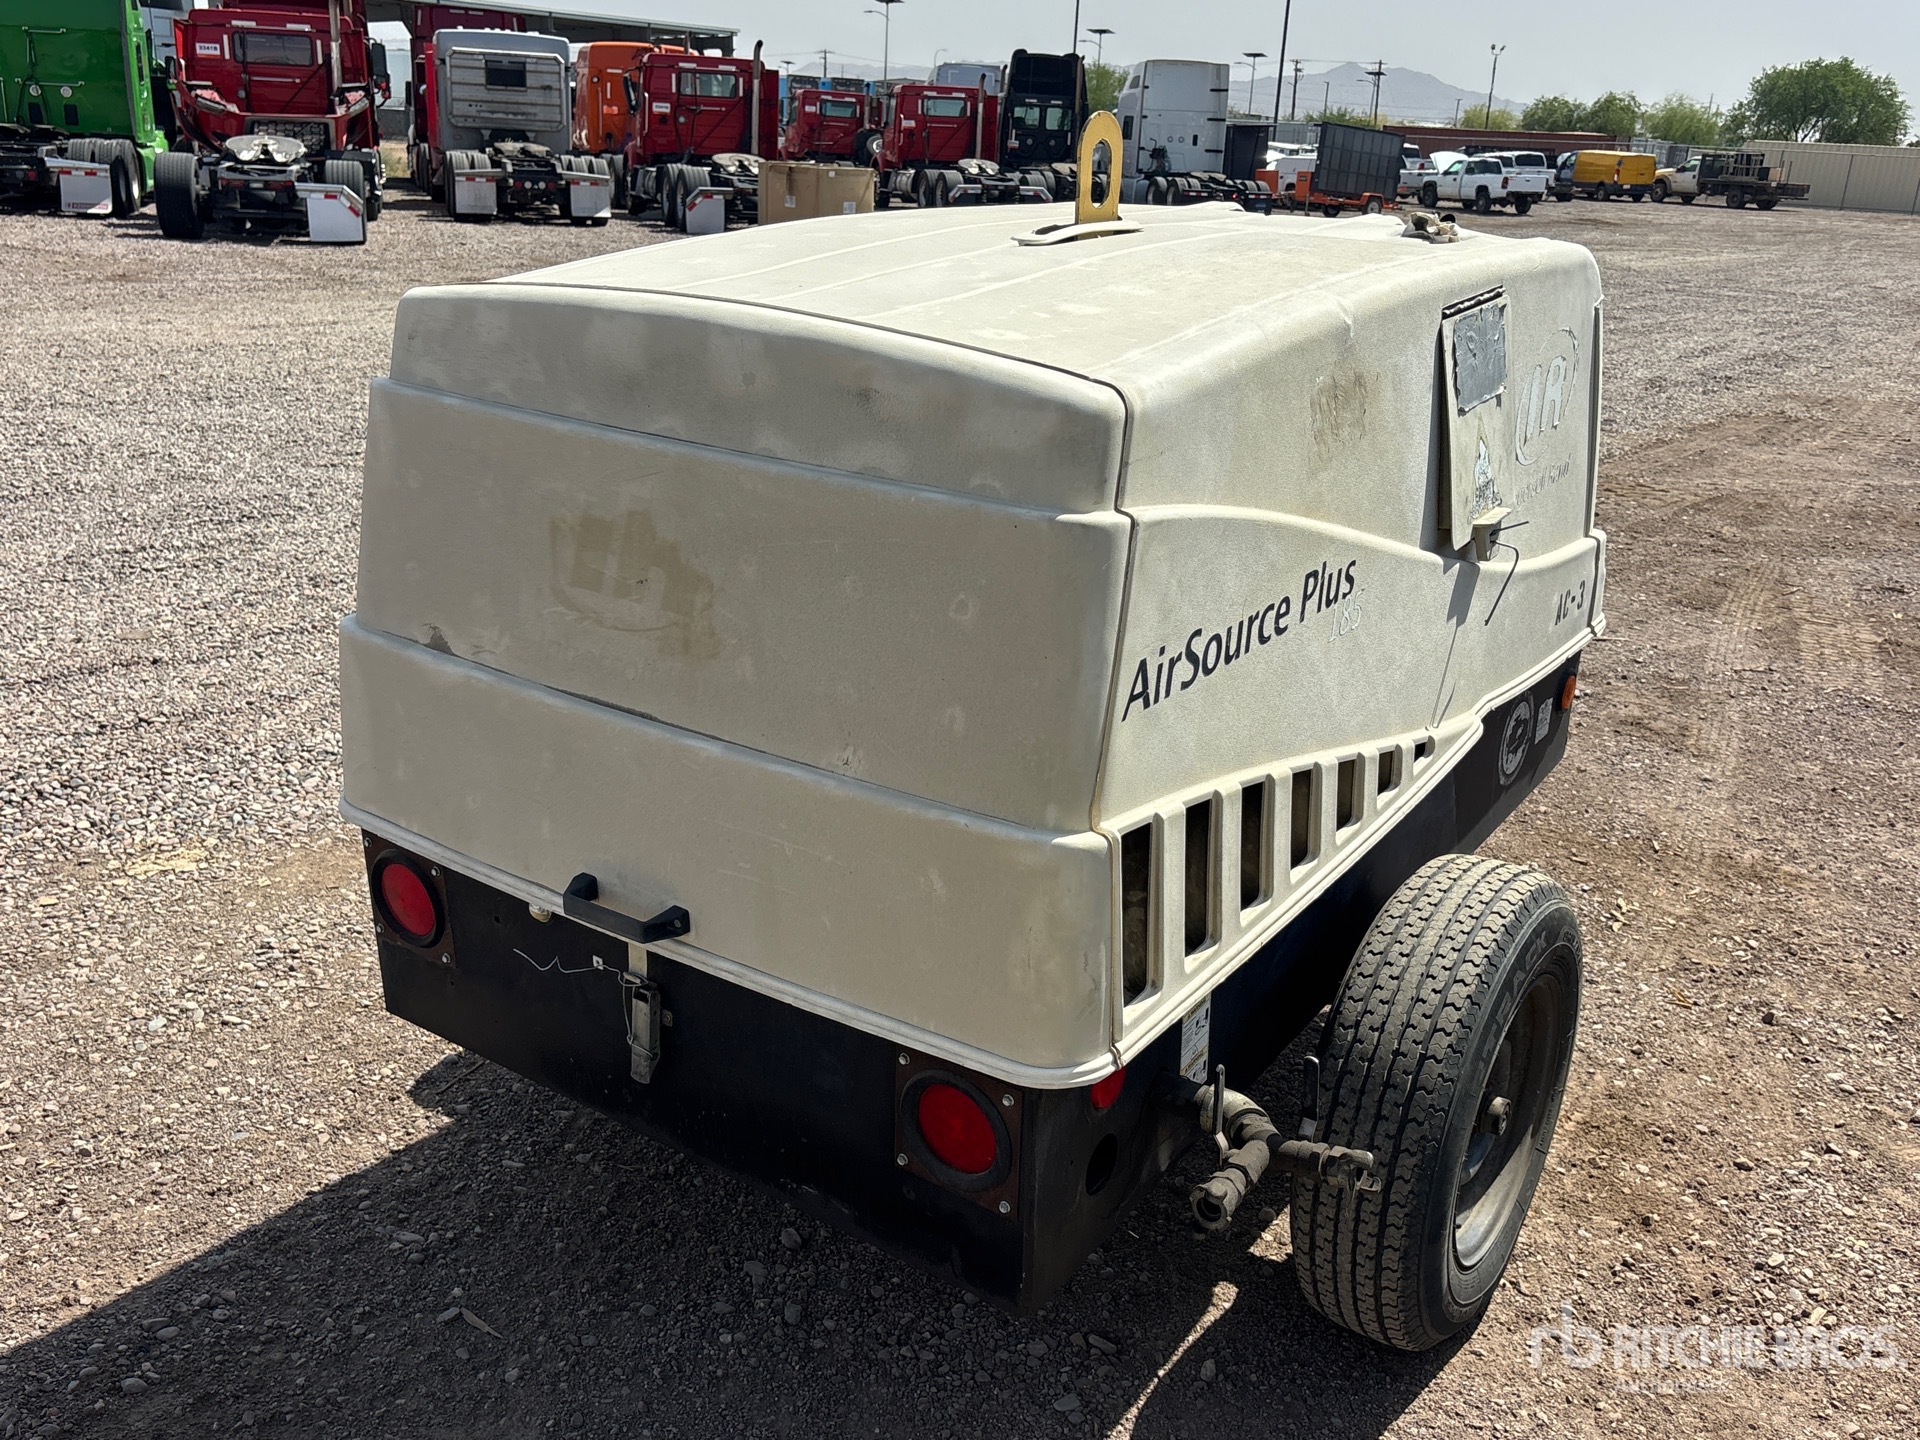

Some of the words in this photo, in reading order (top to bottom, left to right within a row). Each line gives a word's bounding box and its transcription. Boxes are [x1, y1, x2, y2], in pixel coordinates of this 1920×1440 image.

[1524, 355, 1567, 445] IR
[1328, 588, 1366, 643] 185
[1554, 580, 1585, 626] AC-3
[1122, 595, 1291, 721] AirSource
[1299, 559, 1357, 623] Plus
